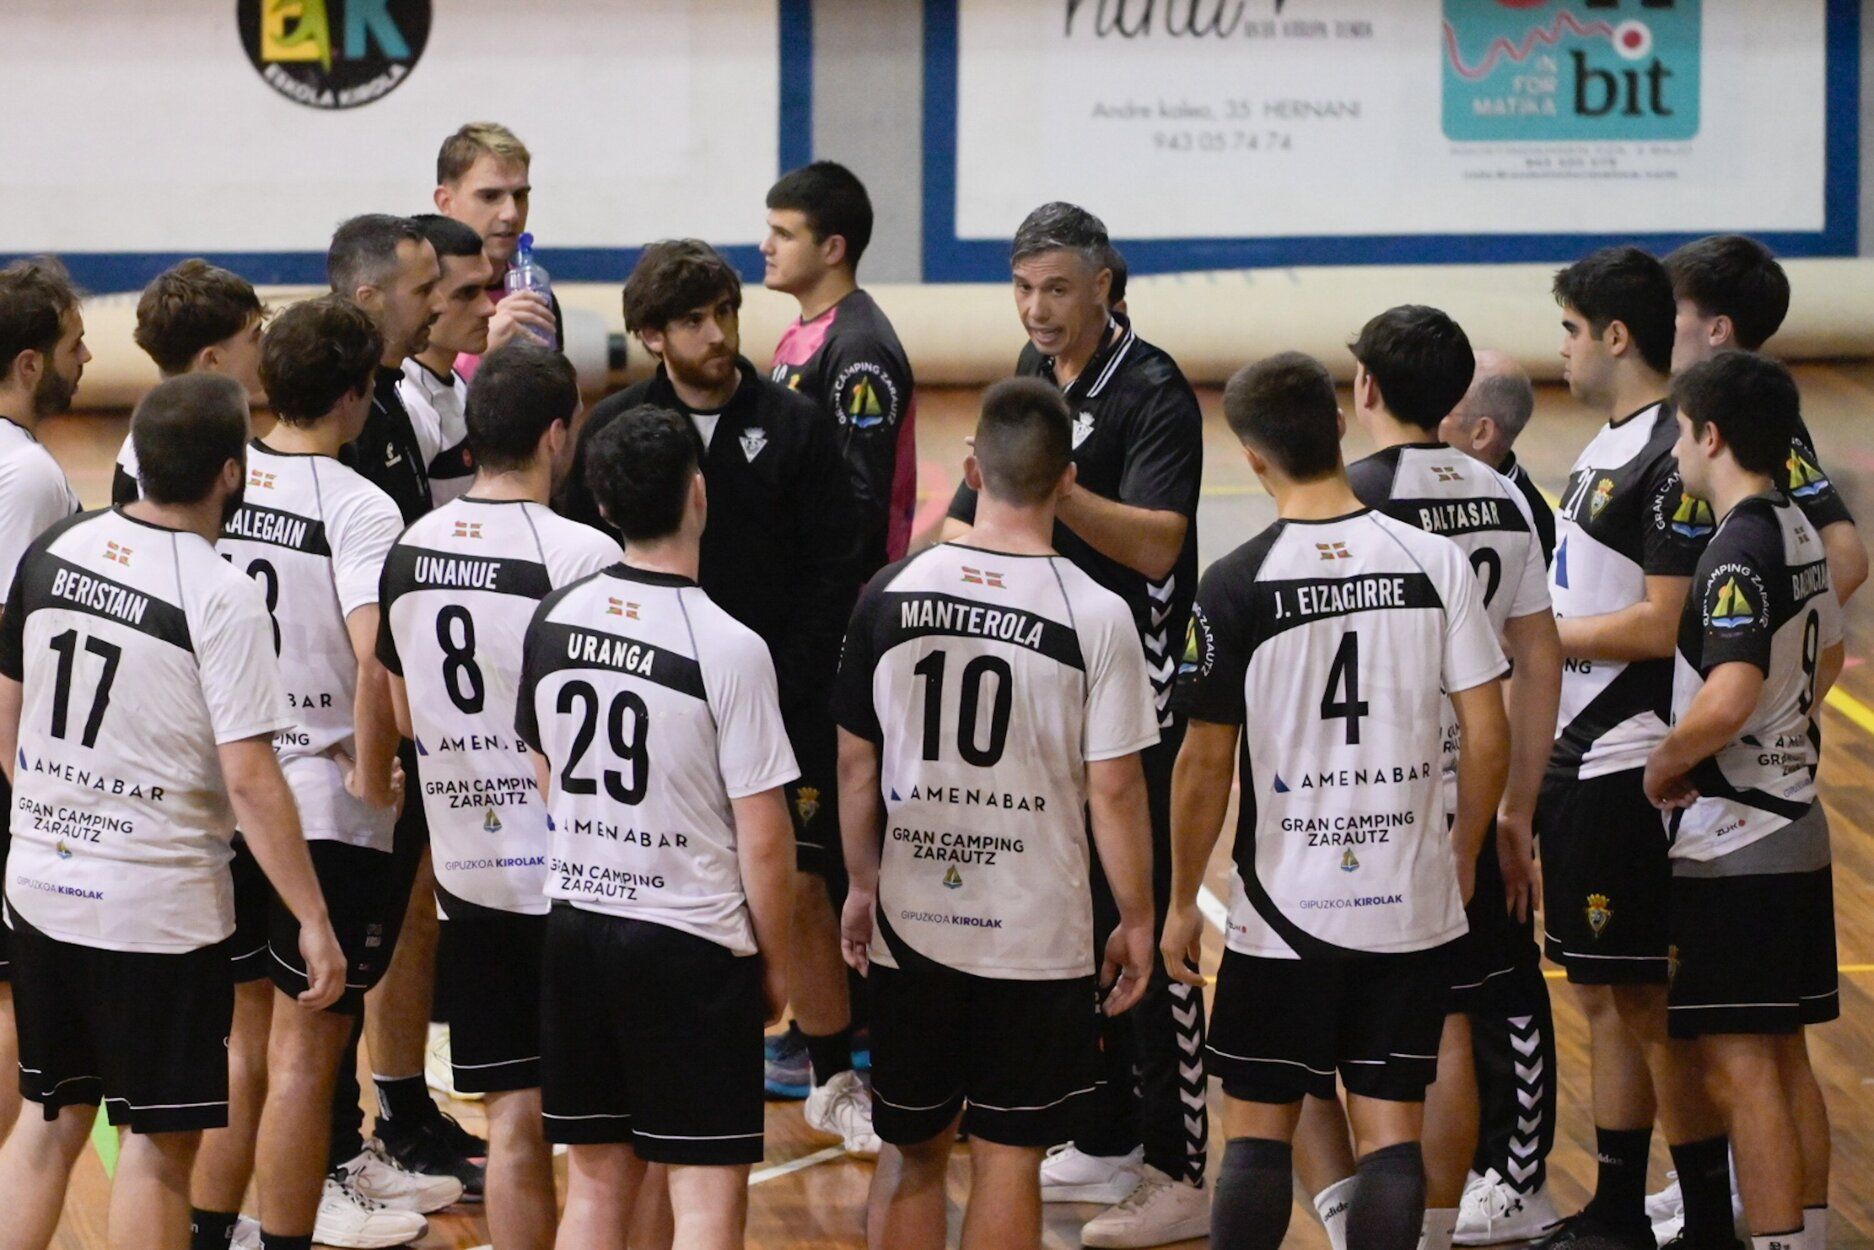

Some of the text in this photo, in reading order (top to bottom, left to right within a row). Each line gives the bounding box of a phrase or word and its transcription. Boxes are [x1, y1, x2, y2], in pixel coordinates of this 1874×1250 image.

[1569, 48, 1674, 117] bit
[225, 508, 307, 548] ALEGAIN
[1418, 500, 1501, 534] BALTASAR
[414, 555, 501, 590] UNANUE
[51, 567, 149, 626] BERISTAIN
[1273, 577, 1406, 620] J. EIZAGIRRE
[900, 599, 1045, 650] MANTEROLA
[435, 604, 485, 716] 8
[567, 631, 656, 677] URANGA
[49, 628, 123, 750] 17
[1319, 630, 1370, 745] 4
[913, 649, 1013, 768] 10
[556, 679, 650, 807] 29
[34, 757, 165, 802] AMENABAR
[425, 777, 538, 796] GRAN CAMPIN
[1301, 762, 1431, 789] AMENABAR
[18, 796, 135, 835] GRAN CAMPING
[449, 791, 528, 809] ZARAUTZ
[910, 784, 1047, 813] AMENABAR
[33, 817, 103, 844] ZARAUTZ
[564, 817, 689, 849] MENABAR
[1280, 811, 1415, 833] GRAN CAMPING
[1307, 828, 1390, 847] ZARAUTZ
[892, 827, 1025, 853] GRAN CAMPING
[913, 844, 997, 866] ZARAUTZ
[561, 876, 639, 901] ZARAUTZ
[588, 866, 666, 889] CAMPING
